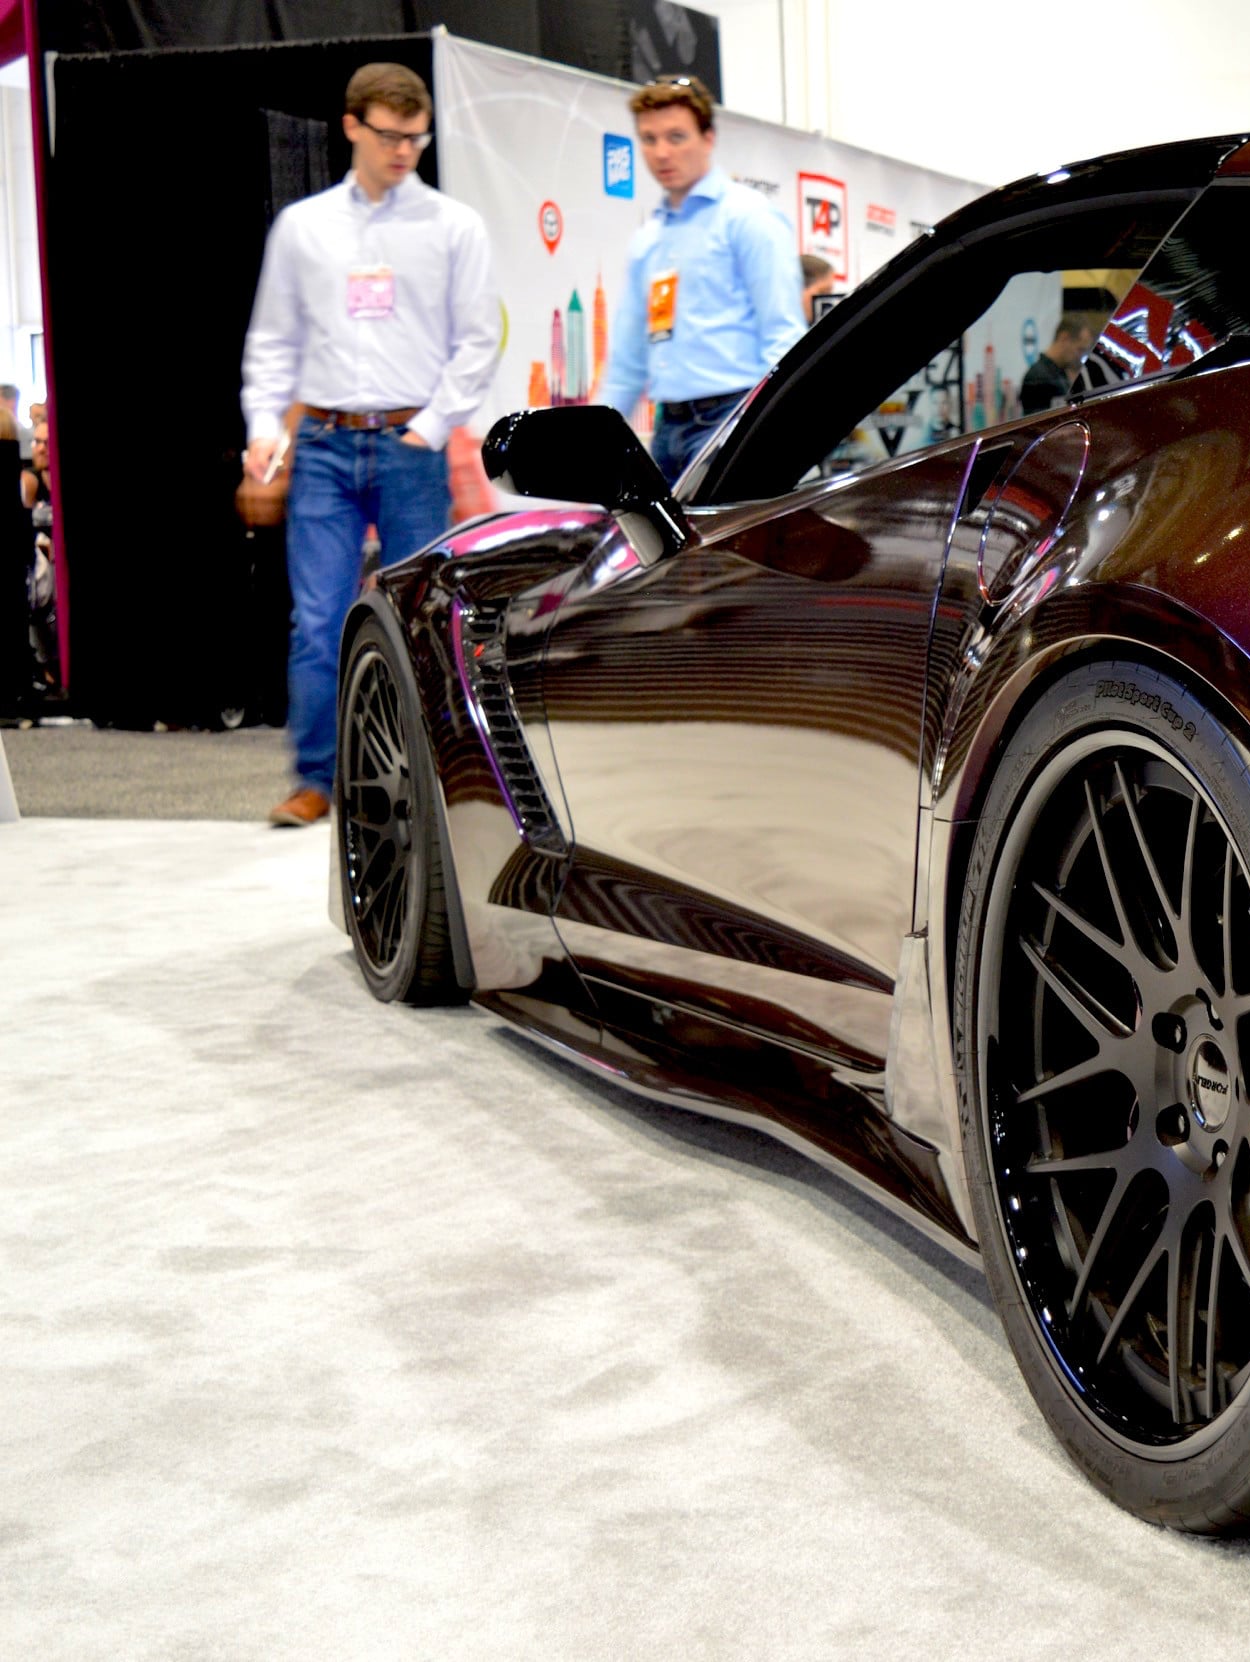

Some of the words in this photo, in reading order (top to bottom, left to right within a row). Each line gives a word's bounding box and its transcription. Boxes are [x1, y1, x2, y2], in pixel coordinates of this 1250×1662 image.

[1095, 680, 1125, 698] Pilot
[1124, 683, 1161, 712] Sport
[1161, 701, 1184, 731] Cup
[1183, 722, 1197, 743] 2
